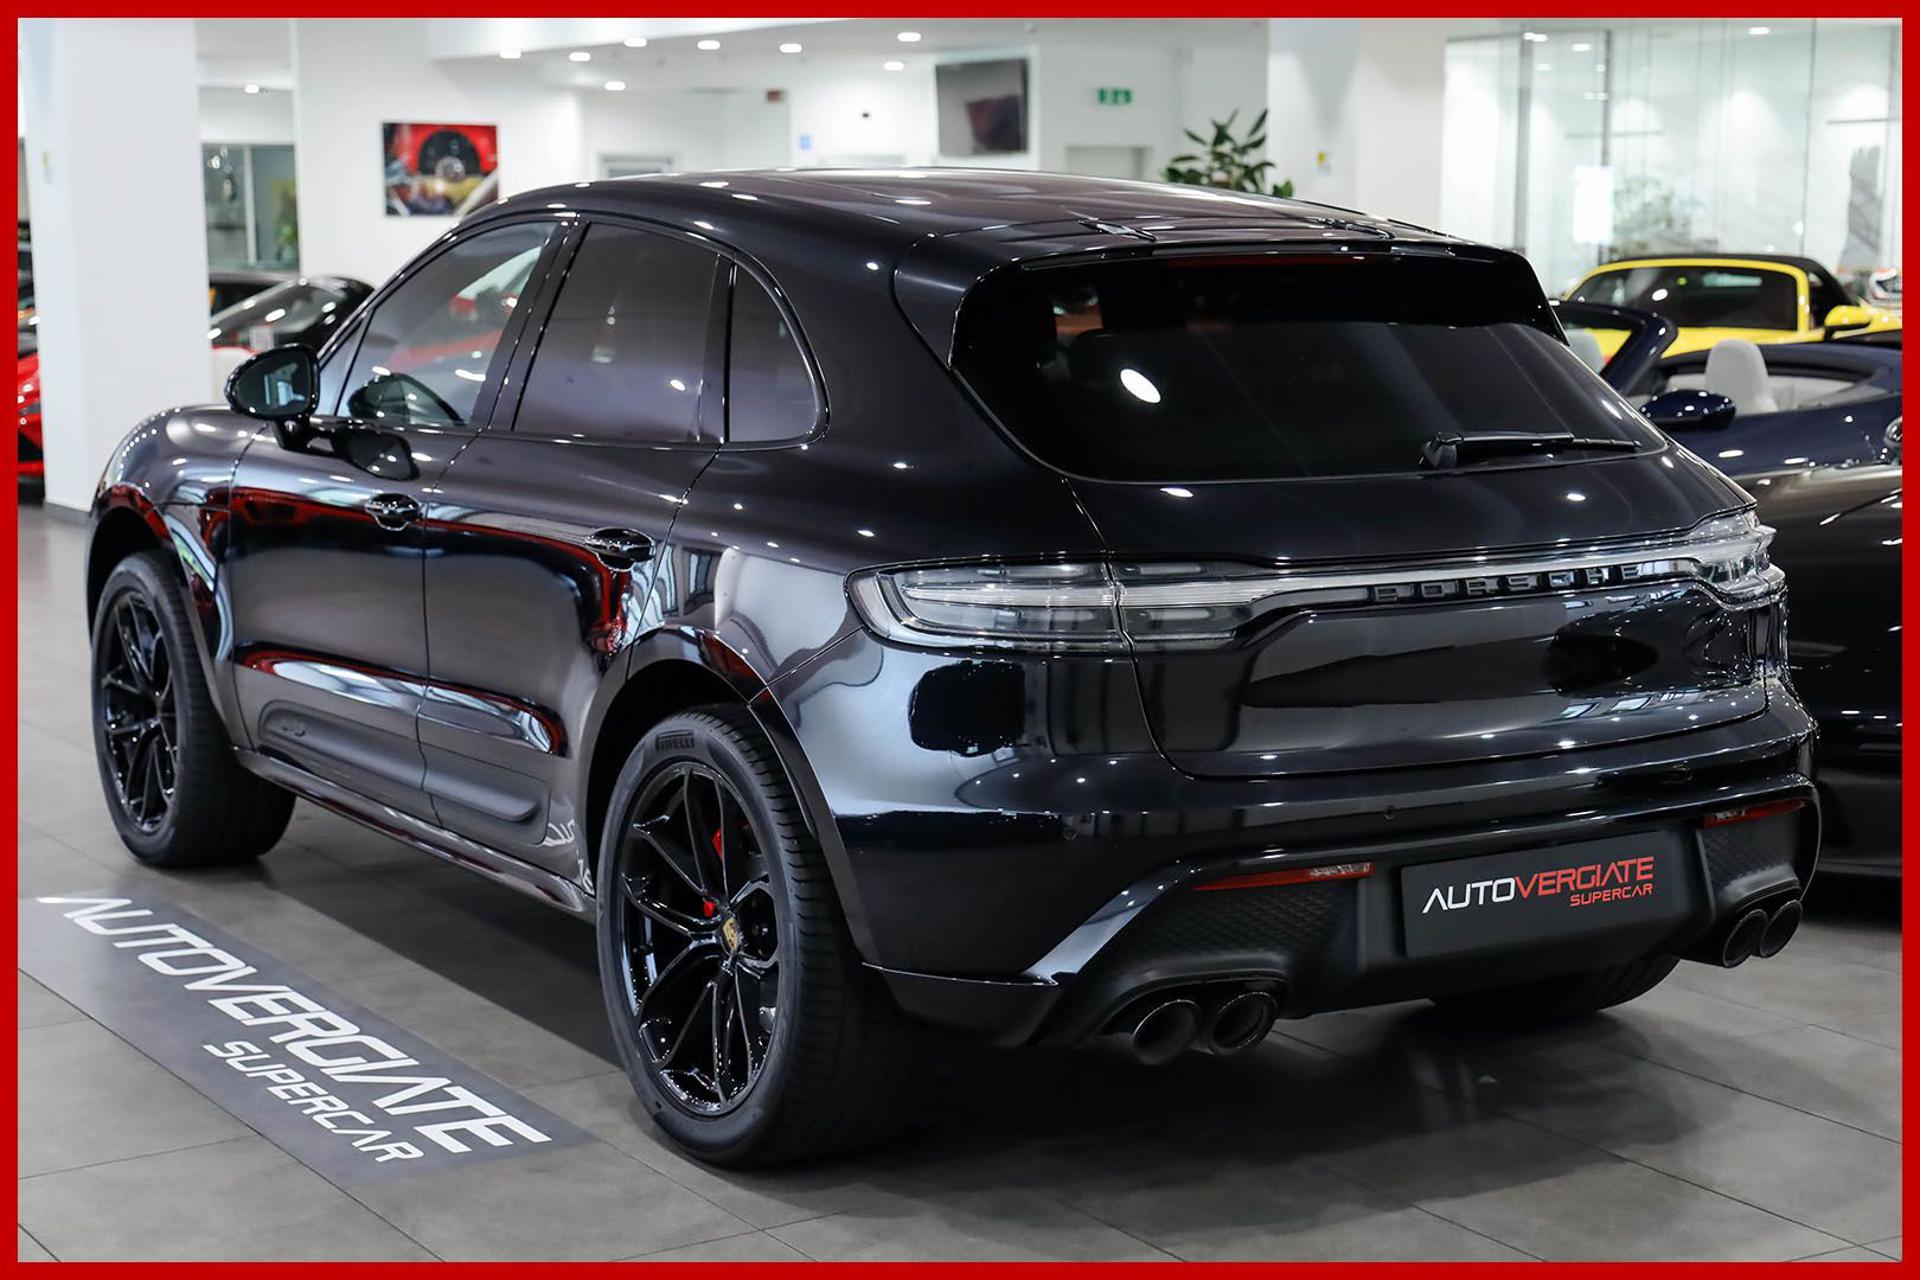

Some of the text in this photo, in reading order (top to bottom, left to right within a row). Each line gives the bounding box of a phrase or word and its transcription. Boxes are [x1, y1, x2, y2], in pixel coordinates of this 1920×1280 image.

[1370, 562, 1646, 603] PORSCHE
[1422, 856, 1655, 914] AUTOVERGIATE
[1570, 882, 1654, 907] SUPERCAR
[36, 896, 553, 1154] AUTOVERGIATE
[202, 1040, 425, 1163] SUPERCAR
